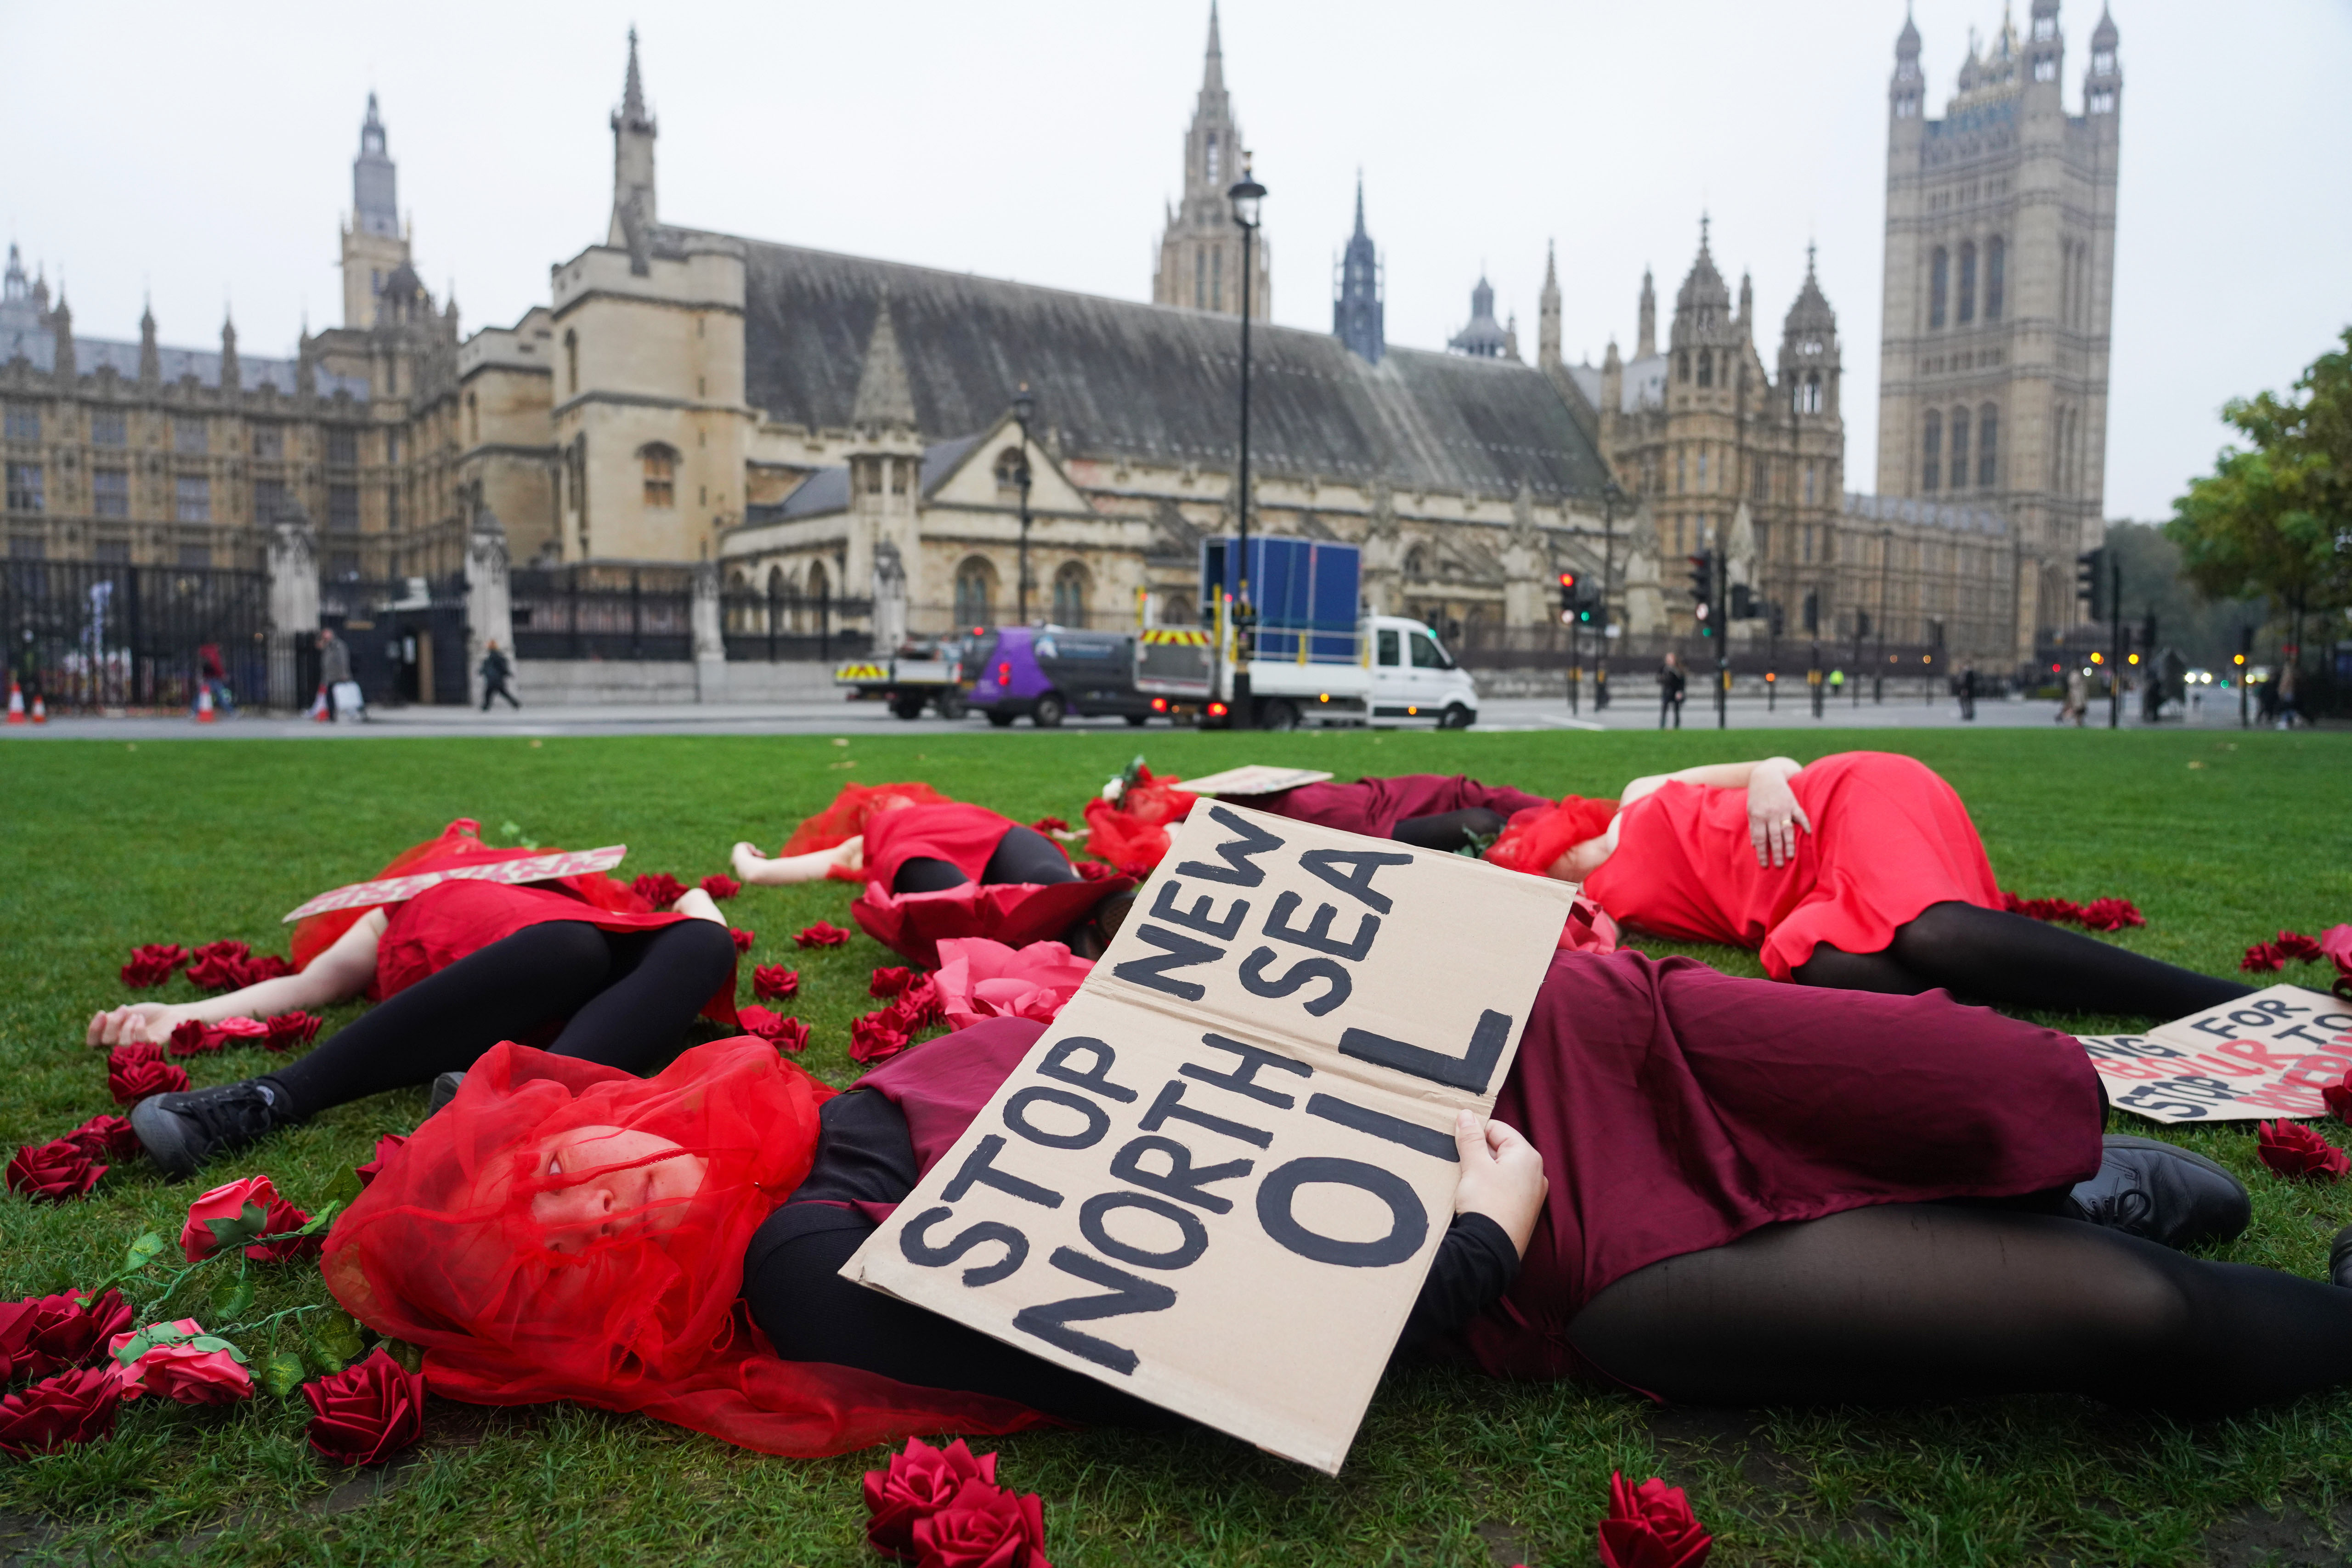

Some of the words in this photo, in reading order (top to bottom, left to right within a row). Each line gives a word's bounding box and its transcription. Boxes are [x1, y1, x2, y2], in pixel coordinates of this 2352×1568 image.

[899, 1036, 1139, 1288] STOP
[1113, 805, 1286, 1003] NEW
[2190, 1000, 2312, 1039] FOR
[2272, 1013, 2352, 1045] TO
[1012, 1032, 1314, 1376] NORTH
[1238, 848, 1414, 1017] SEA
[1255, 1008, 1513, 1268] OIL
[2116, 1076, 2250, 1117] STOP
